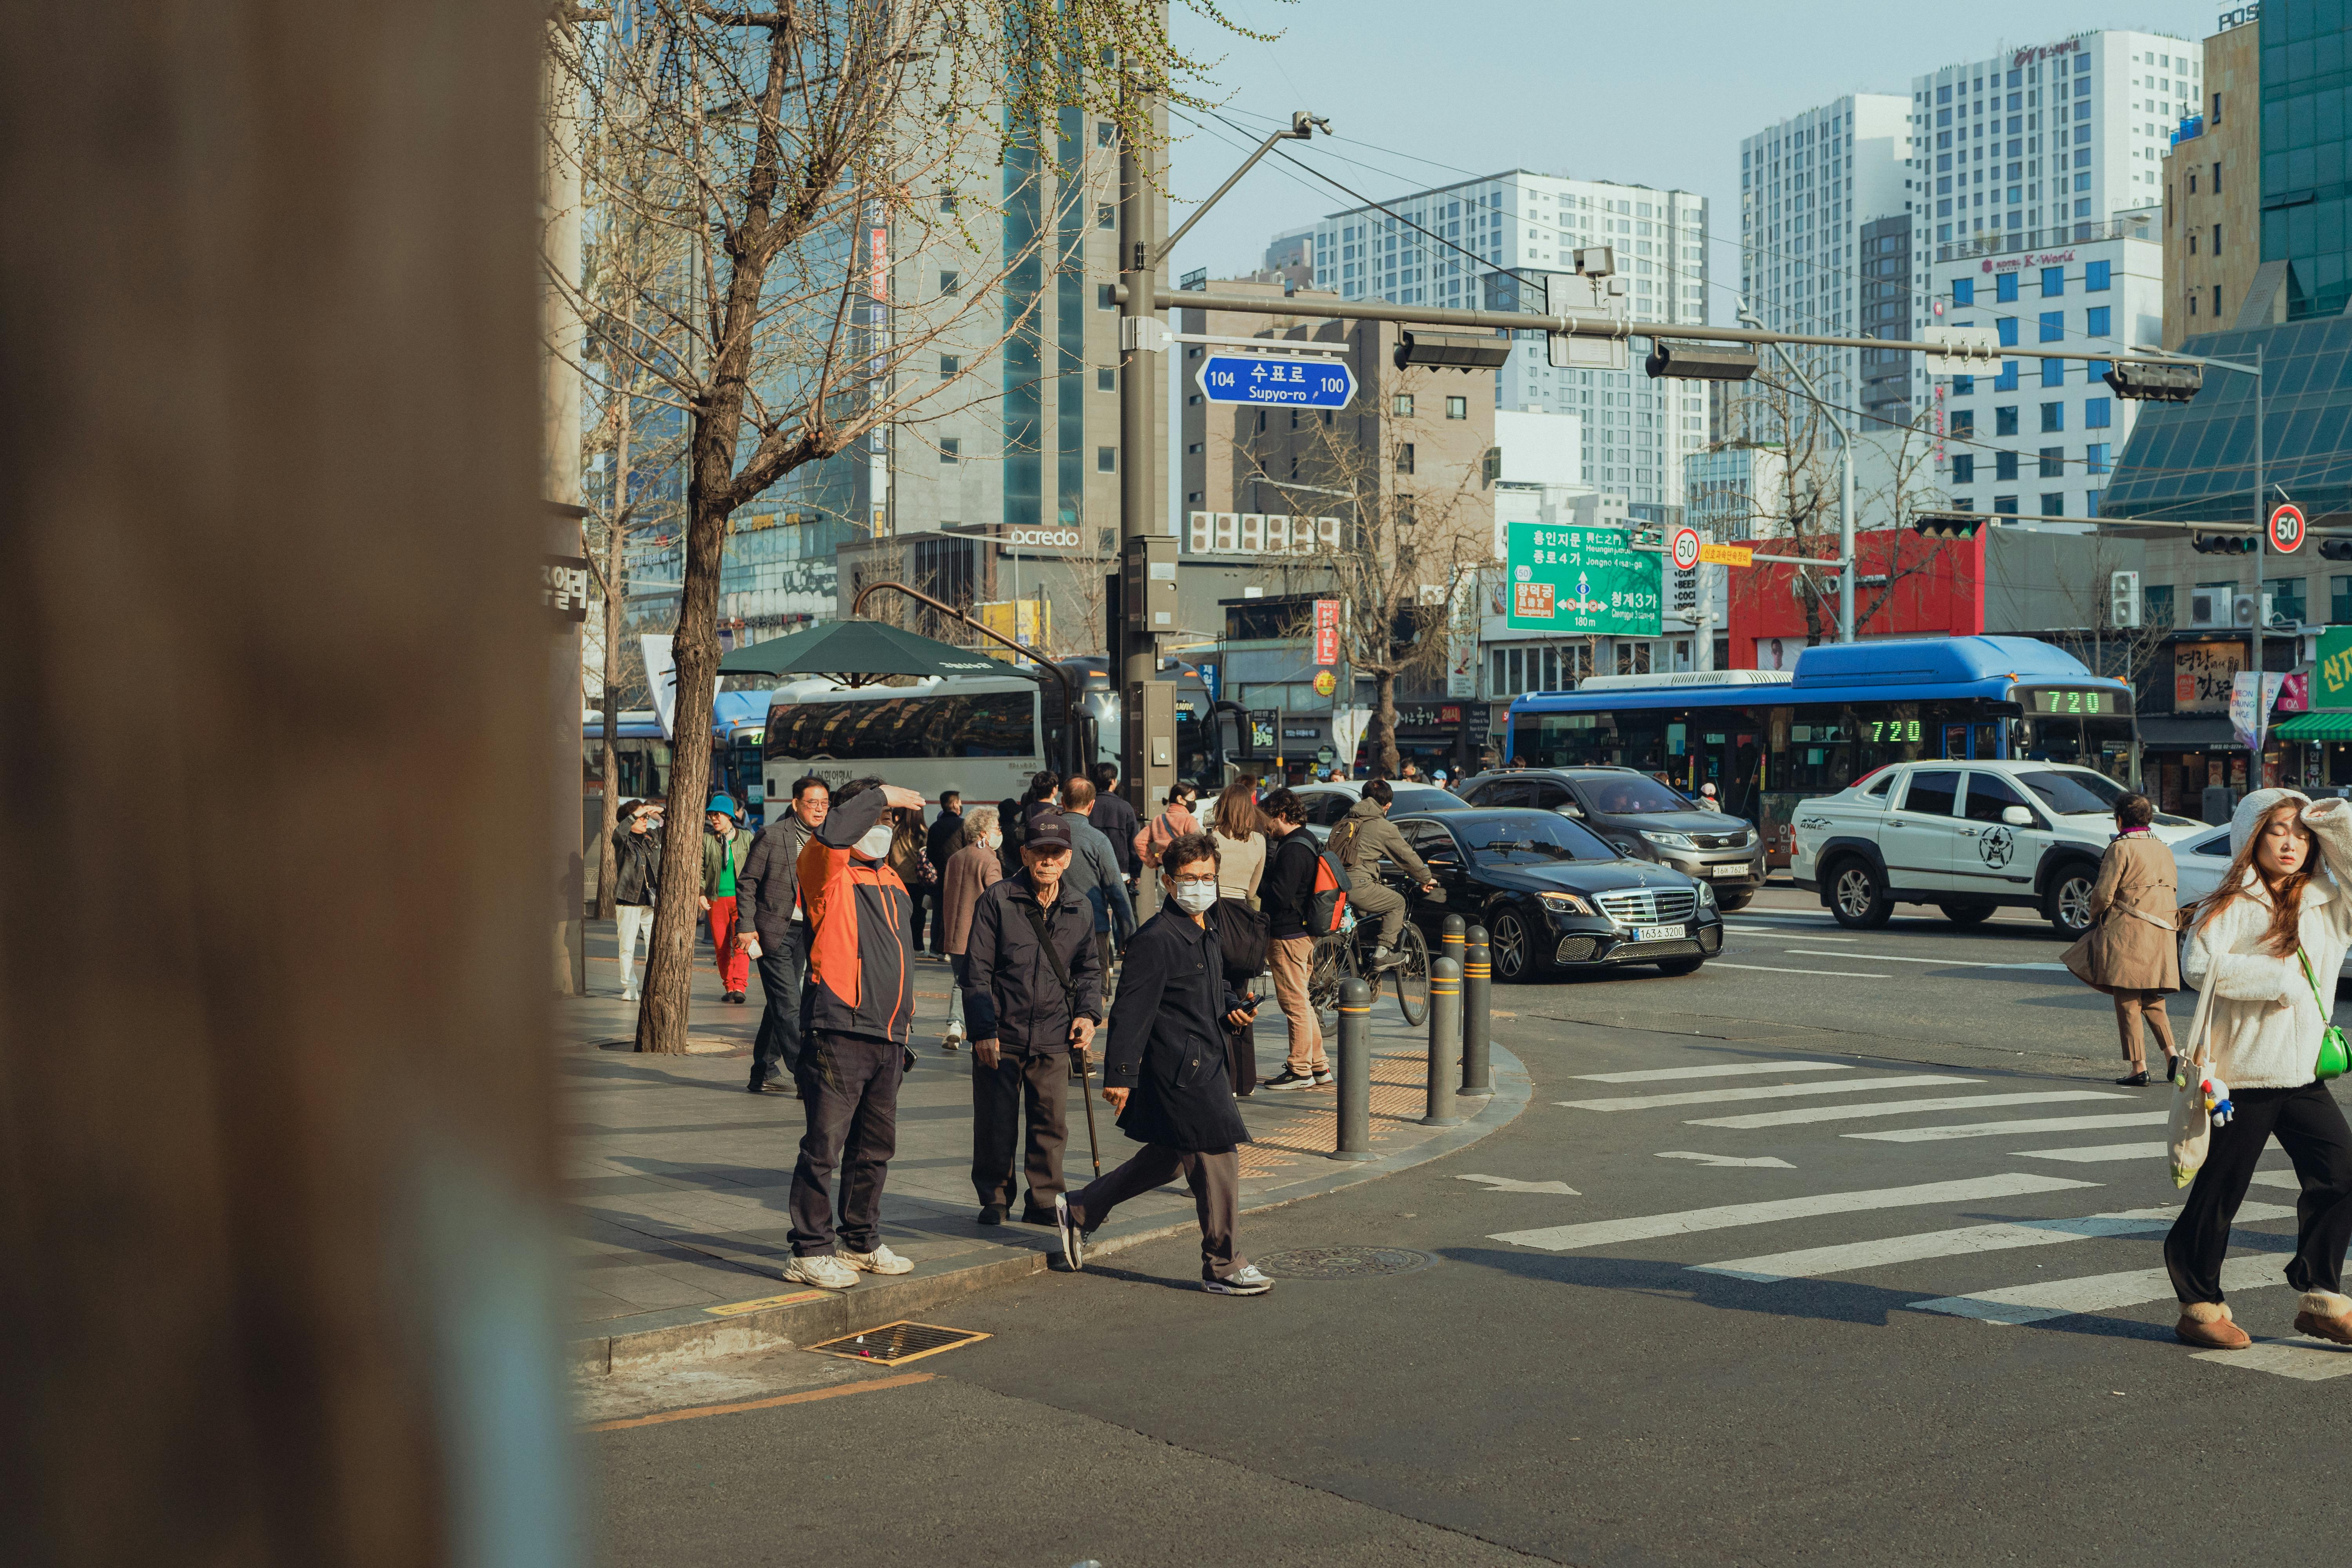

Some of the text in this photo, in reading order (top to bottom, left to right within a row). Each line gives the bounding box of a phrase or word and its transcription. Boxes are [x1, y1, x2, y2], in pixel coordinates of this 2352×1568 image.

[1210, 371, 1235, 387] 104
[1251, 363, 1305, 383] 수표로
[1321, 377, 1344, 393] 100
[1249, 386, 1306, 402] Supyo-ro
[2277, 517, 2297, 540] 50
[1011, 528, 1079, 547] acredo
[1534, 530, 1581, 548] 흥인지문
[1679, 540, 1695, 557] 50
[1704, 548, 1749, 562] 신호과속단속장비
[1534, 549, 1581, 566] 종로4가
[1586, 557, 1612, 568] Jongno
[1518, 569, 1528, 577] 50
[1518, 584, 1552, 599] 창덕궁
[1580, 583, 1586, 593] 6
[1611, 591, 1657, 609] 청계3가
[2177, 649, 2214, 671] 명랑
[2048, 691, 2099, 713] 720
[1253, 731, 1273, 746] BAB
[1871, 720, 1920, 742] 720
[1641, 927, 1683, 938] 163소 3200
